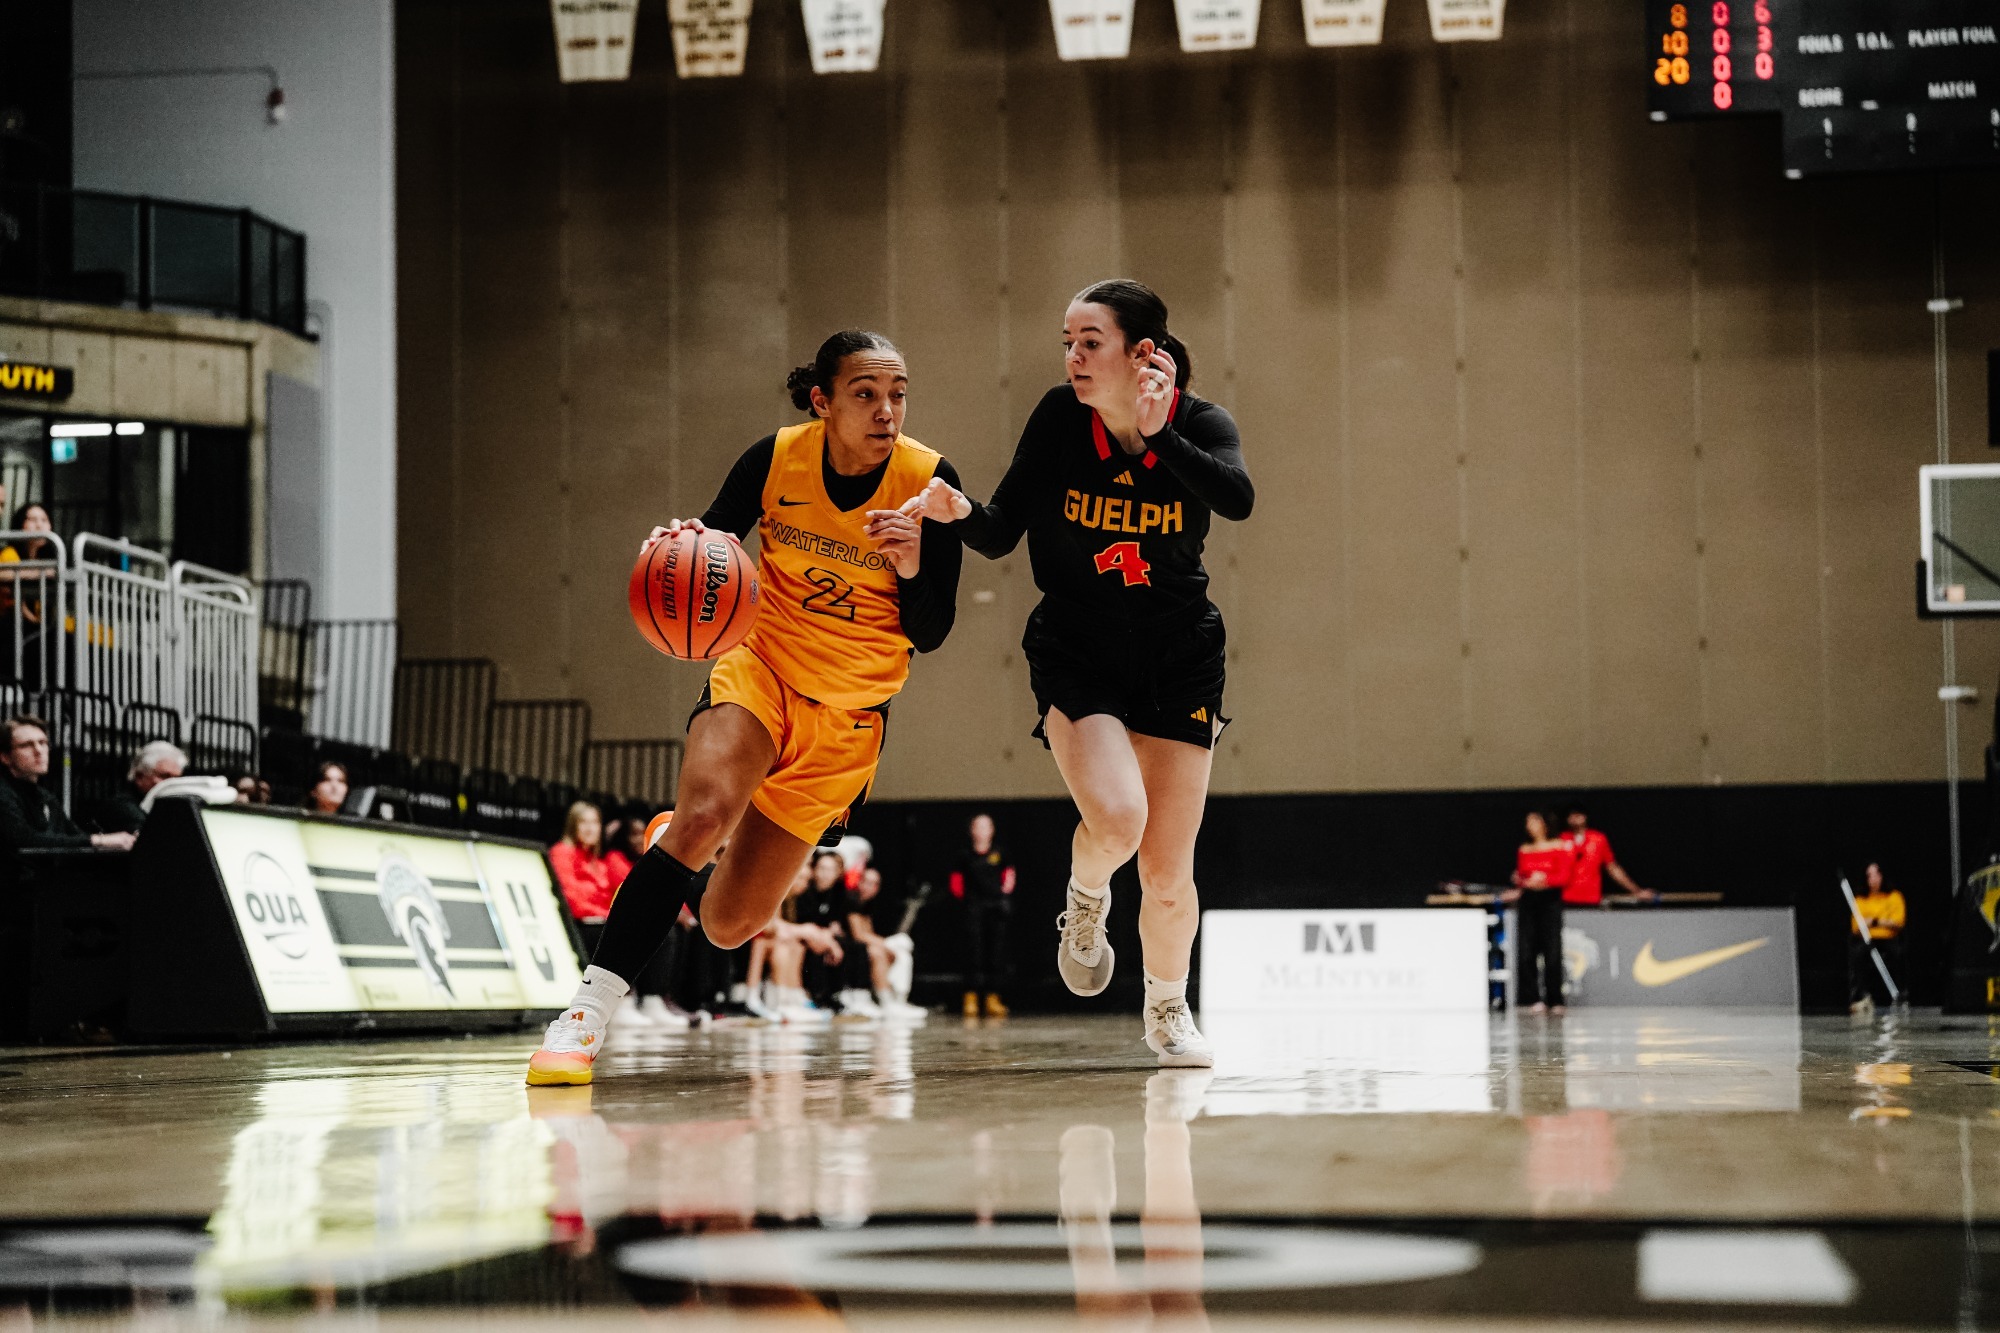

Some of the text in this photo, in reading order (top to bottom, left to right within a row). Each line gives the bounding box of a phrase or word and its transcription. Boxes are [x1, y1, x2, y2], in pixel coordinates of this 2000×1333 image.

[1713, 28, 1731, 54] 0
[1654, 57, 1690, 85] 20
[1713, 55, 1732, 81] 0
[1755, 52, 1774, 80] 0
[1713, 82, 1732, 109] 0
[0, 363, 55, 393] UTH
[1064, 488, 1183, 535] GUELPH
[1094, 541, 1151, 587] 4
[698, 541, 729, 623] Wilson
[802, 566, 855, 622] 2
[246, 892, 309, 926] OUA
